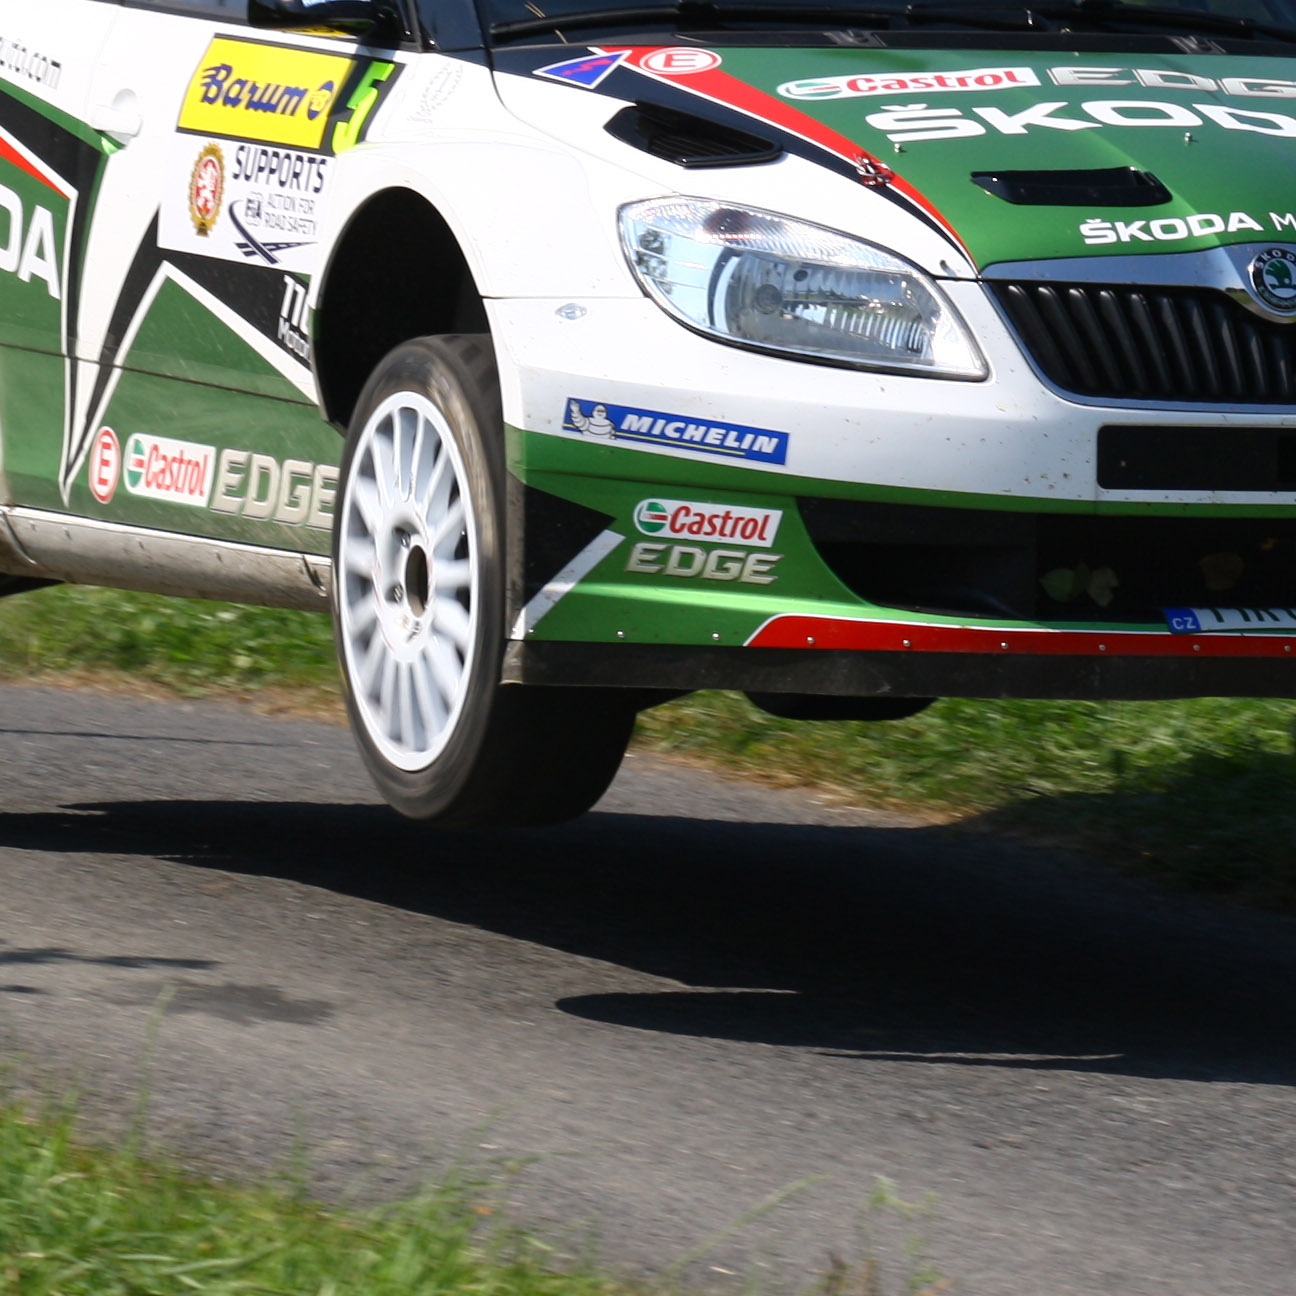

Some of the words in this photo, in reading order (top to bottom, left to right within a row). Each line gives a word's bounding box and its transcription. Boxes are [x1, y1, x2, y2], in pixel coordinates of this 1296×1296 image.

[200, 62, 309, 117] Barum
[846, 70, 1028, 93] Castrol
[332, 61, 396, 154] 5
[232, 144, 328, 194] SUPPORTS
[1078, 212, 1264, 245] ŠKODA
[620, 413, 780, 454] MICHELIN
[145, 444, 211, 497] Castrol
[209, 448, 341, 533] EDGE
[669, 505, 771, 542] Castrol
[625, 541, 785, 585] EDGE
[1172, 617, 1197, 630] CZ
